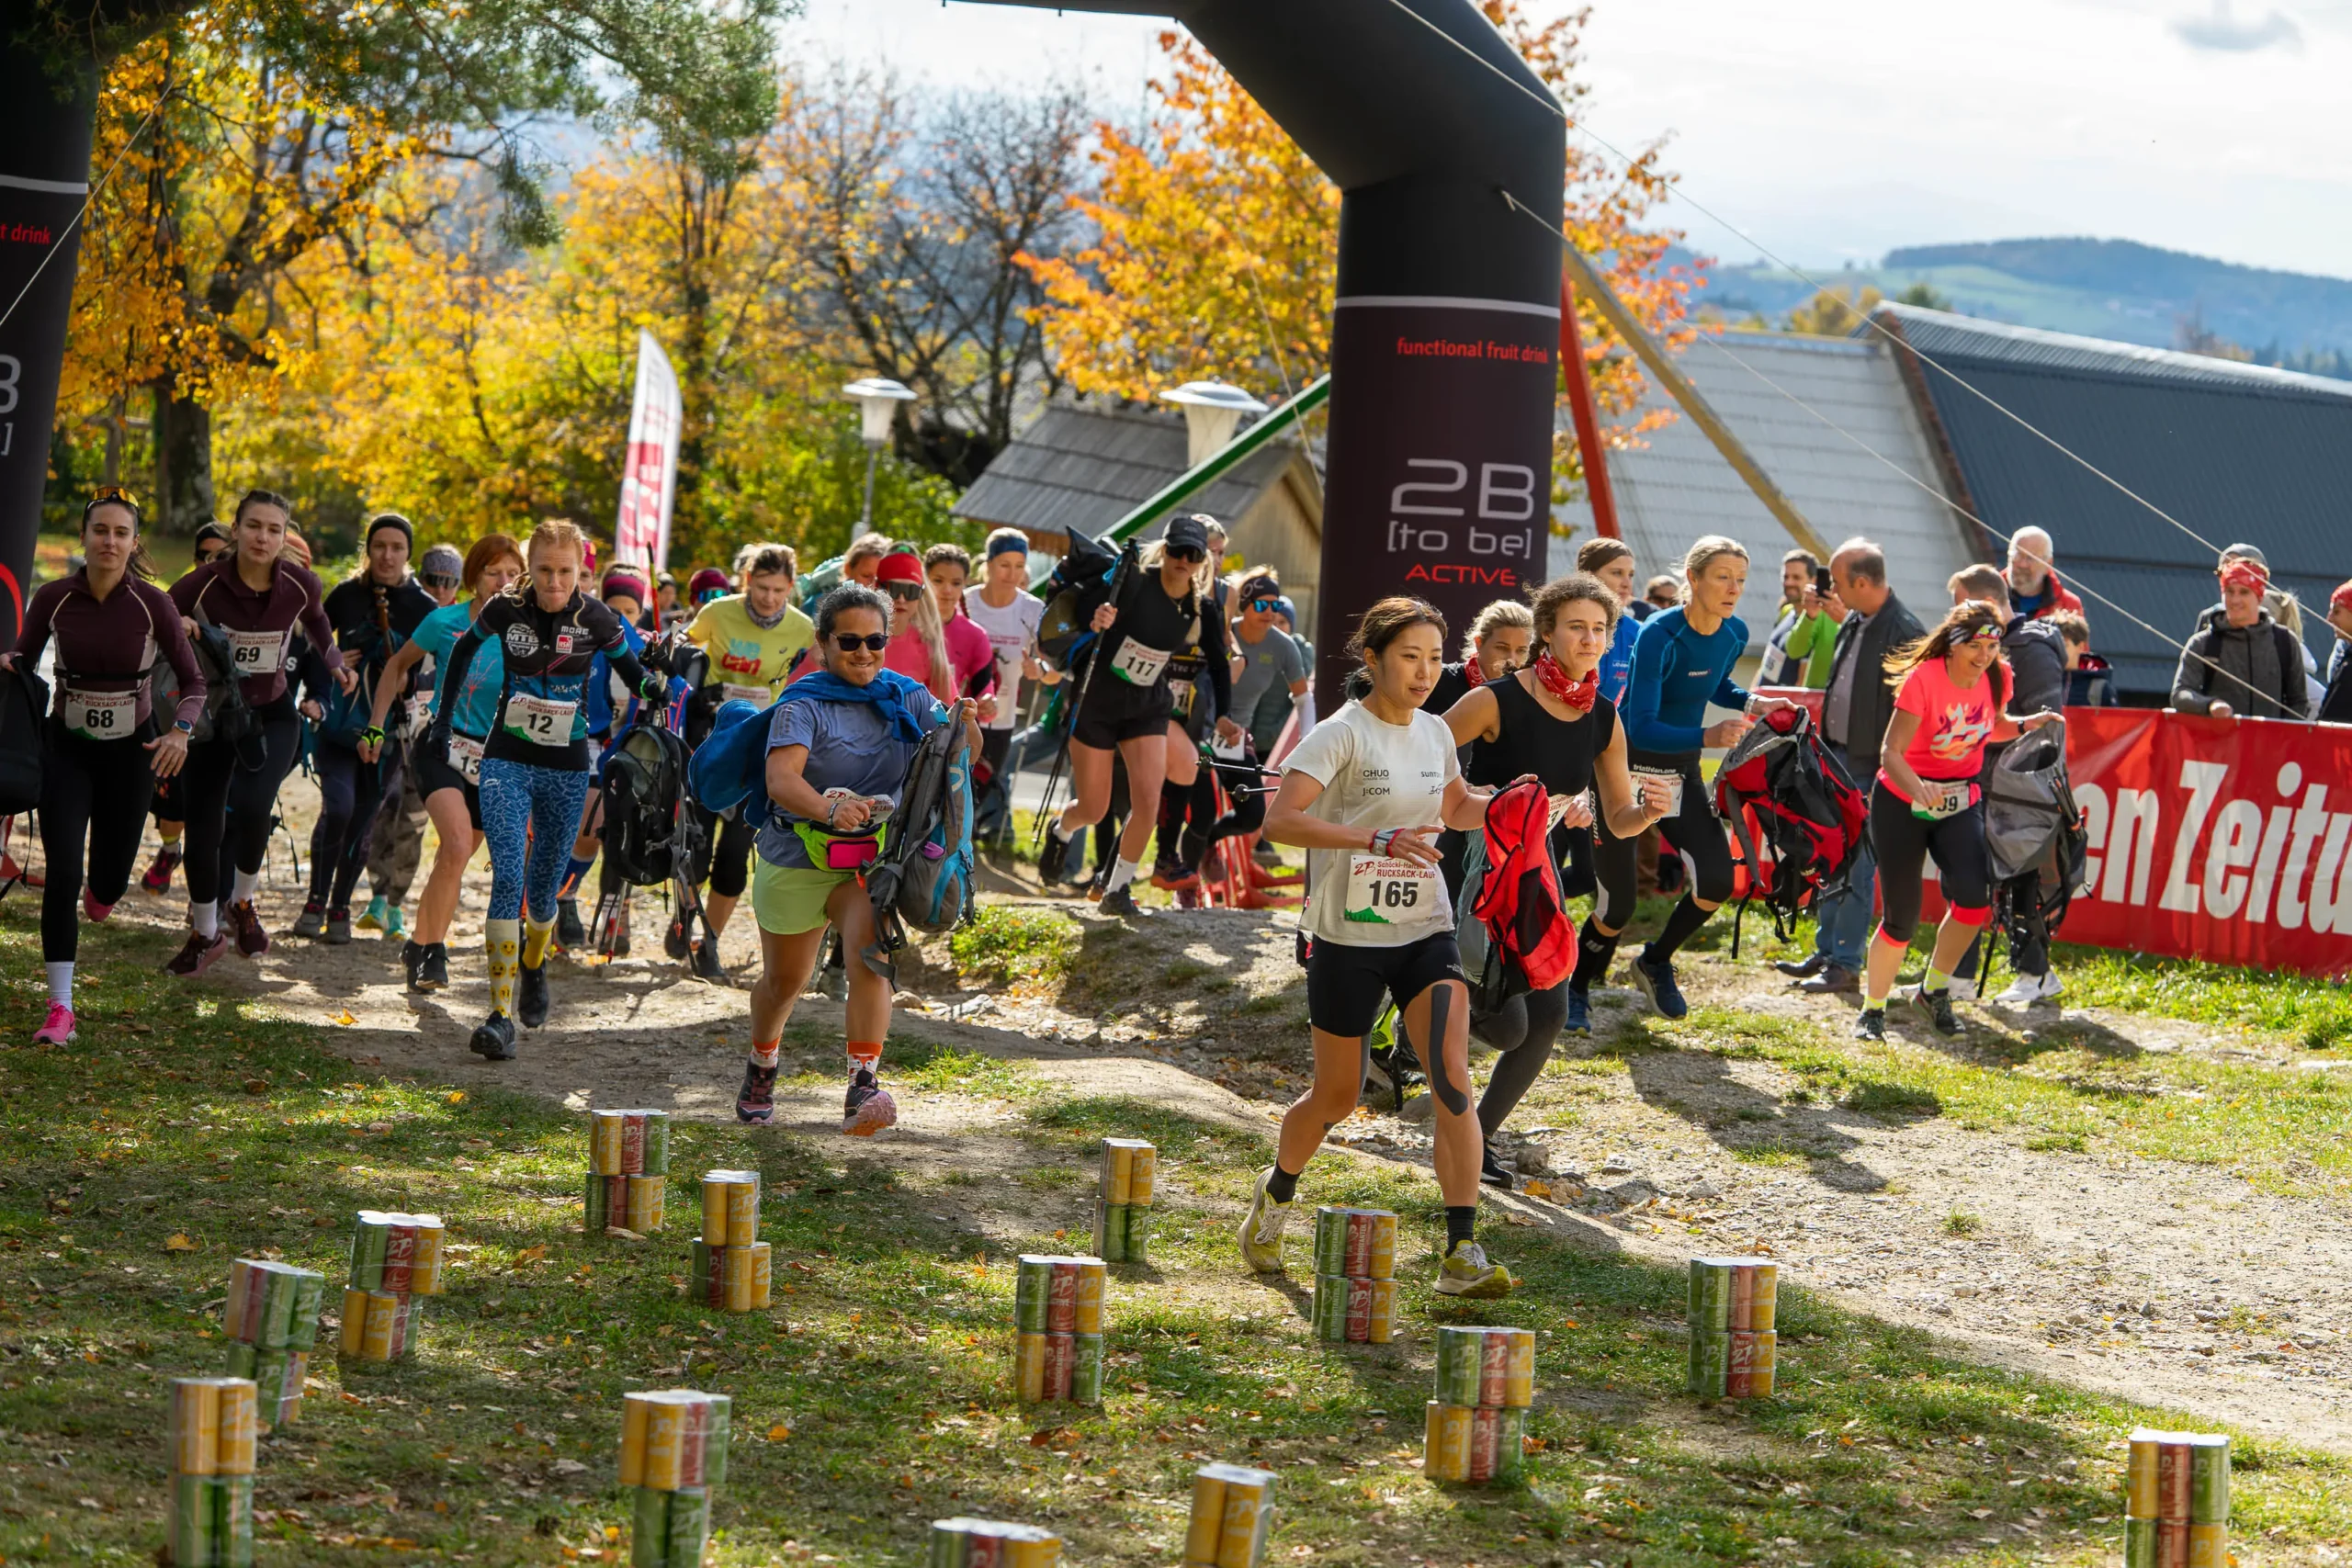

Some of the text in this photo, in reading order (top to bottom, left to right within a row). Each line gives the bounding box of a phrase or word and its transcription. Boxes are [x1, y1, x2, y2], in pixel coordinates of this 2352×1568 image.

[11, 222, 51, 244] drink
[1397, 337, 1549, 364] functional fruit drink
[1391, 458, 1534, 521] 2B
[1405, 563, 1518, 587] ACTIVE
[234, 646, 261, 663] 69
[1126, 655, 1157, 677] 117
[85, 708, 114, 728] 68
[527, 713, 554, 735] 12
[1363, 769, 1390, 778] CHUO
[1362, 786, 1391, 797] J:COM
[1353, 861, 1377, 876] 2B
[1369, 879, 1419, 908] 165
[387, 1237, 413, 1259] 2B
